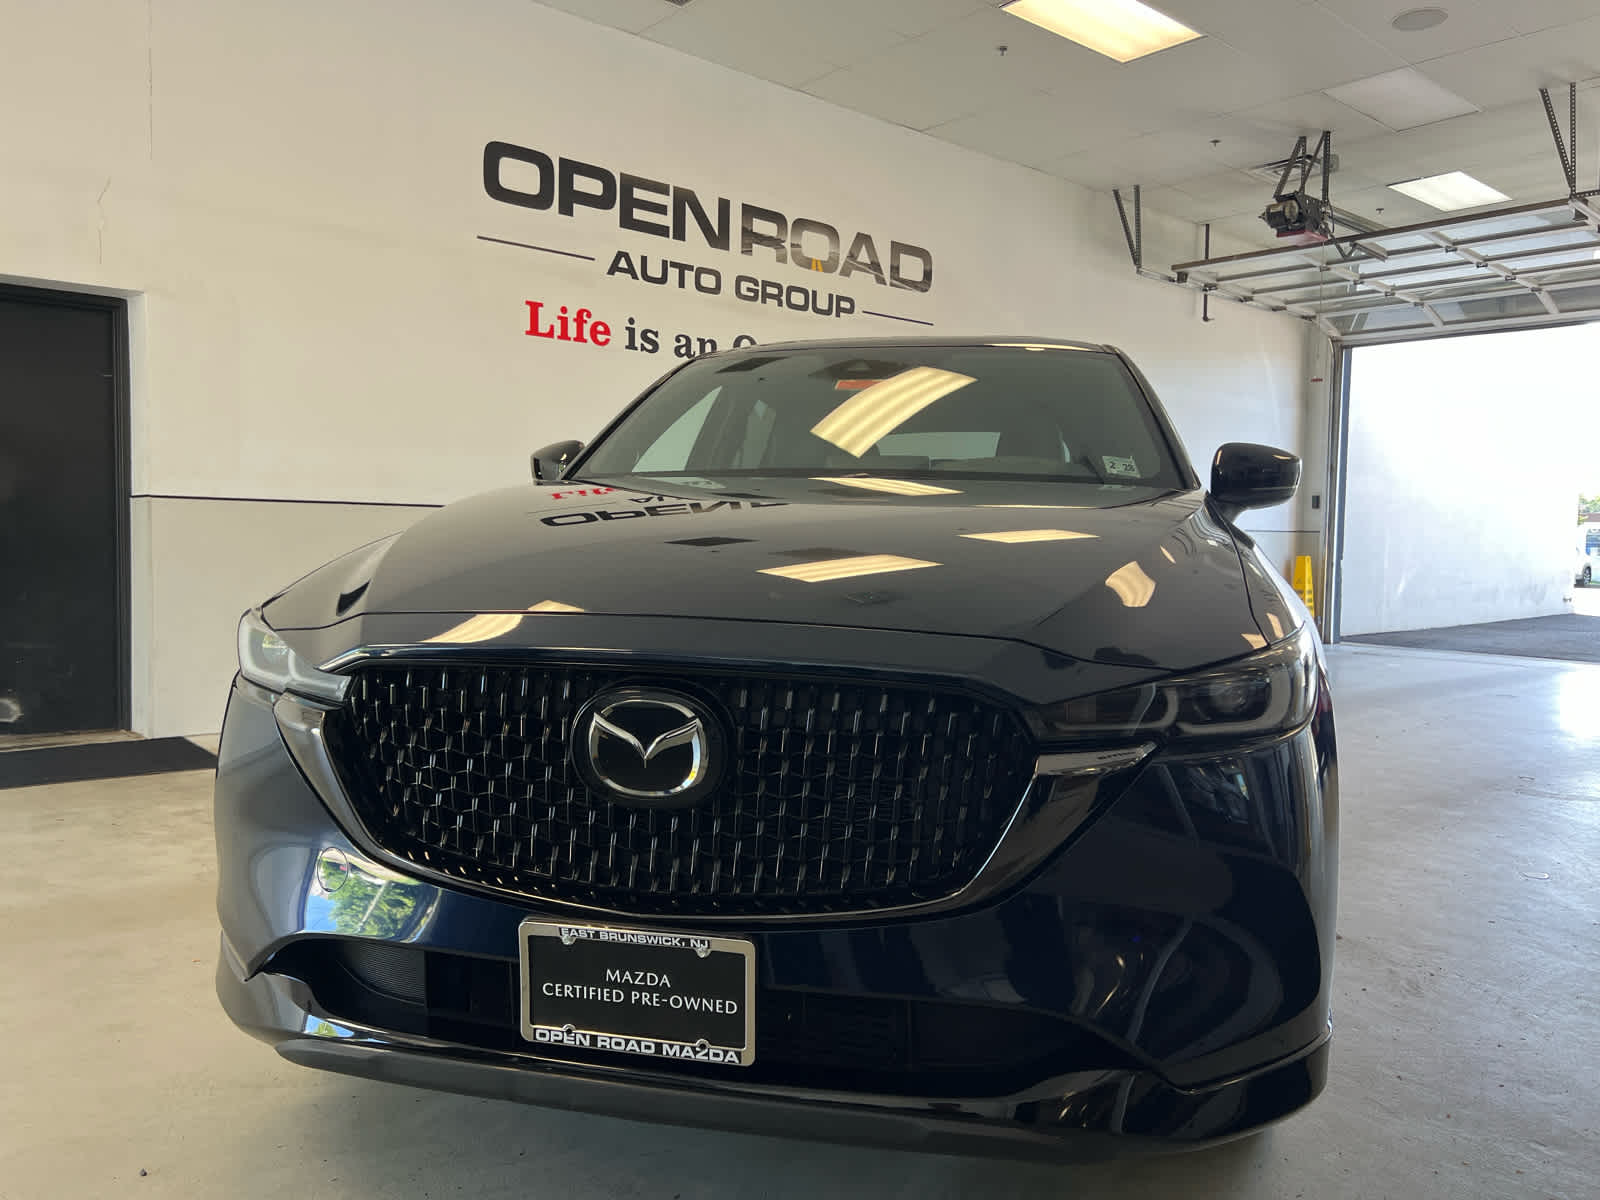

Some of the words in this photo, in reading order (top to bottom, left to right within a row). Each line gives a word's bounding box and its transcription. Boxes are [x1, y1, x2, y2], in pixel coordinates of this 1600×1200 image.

[483, 140, 731, 251] OPEN
[606, 250, 722, 296] AUTO
[734, 274, 856, 318] GROUP
[525, 300, 612, 347] Life
[624, 317, 661, 354] is
[673, 334, 718, 359] an
[561, 927, 595, 939] EAST
[600, 931, 686, 947] BRUNSWICK,
[690, 939, 709, 948] NJ
[605, 968, 672, 988] MAZDA
[542, 982, 625, 1003] CERTIFIED
[631, 991, 738, 1015] PRE-OWNED
[535, 1029, 591, 1047] OPEN
[597, 1036, 656, 1054] ROAD
[662, 1043, 740, 1064] MAZDA
